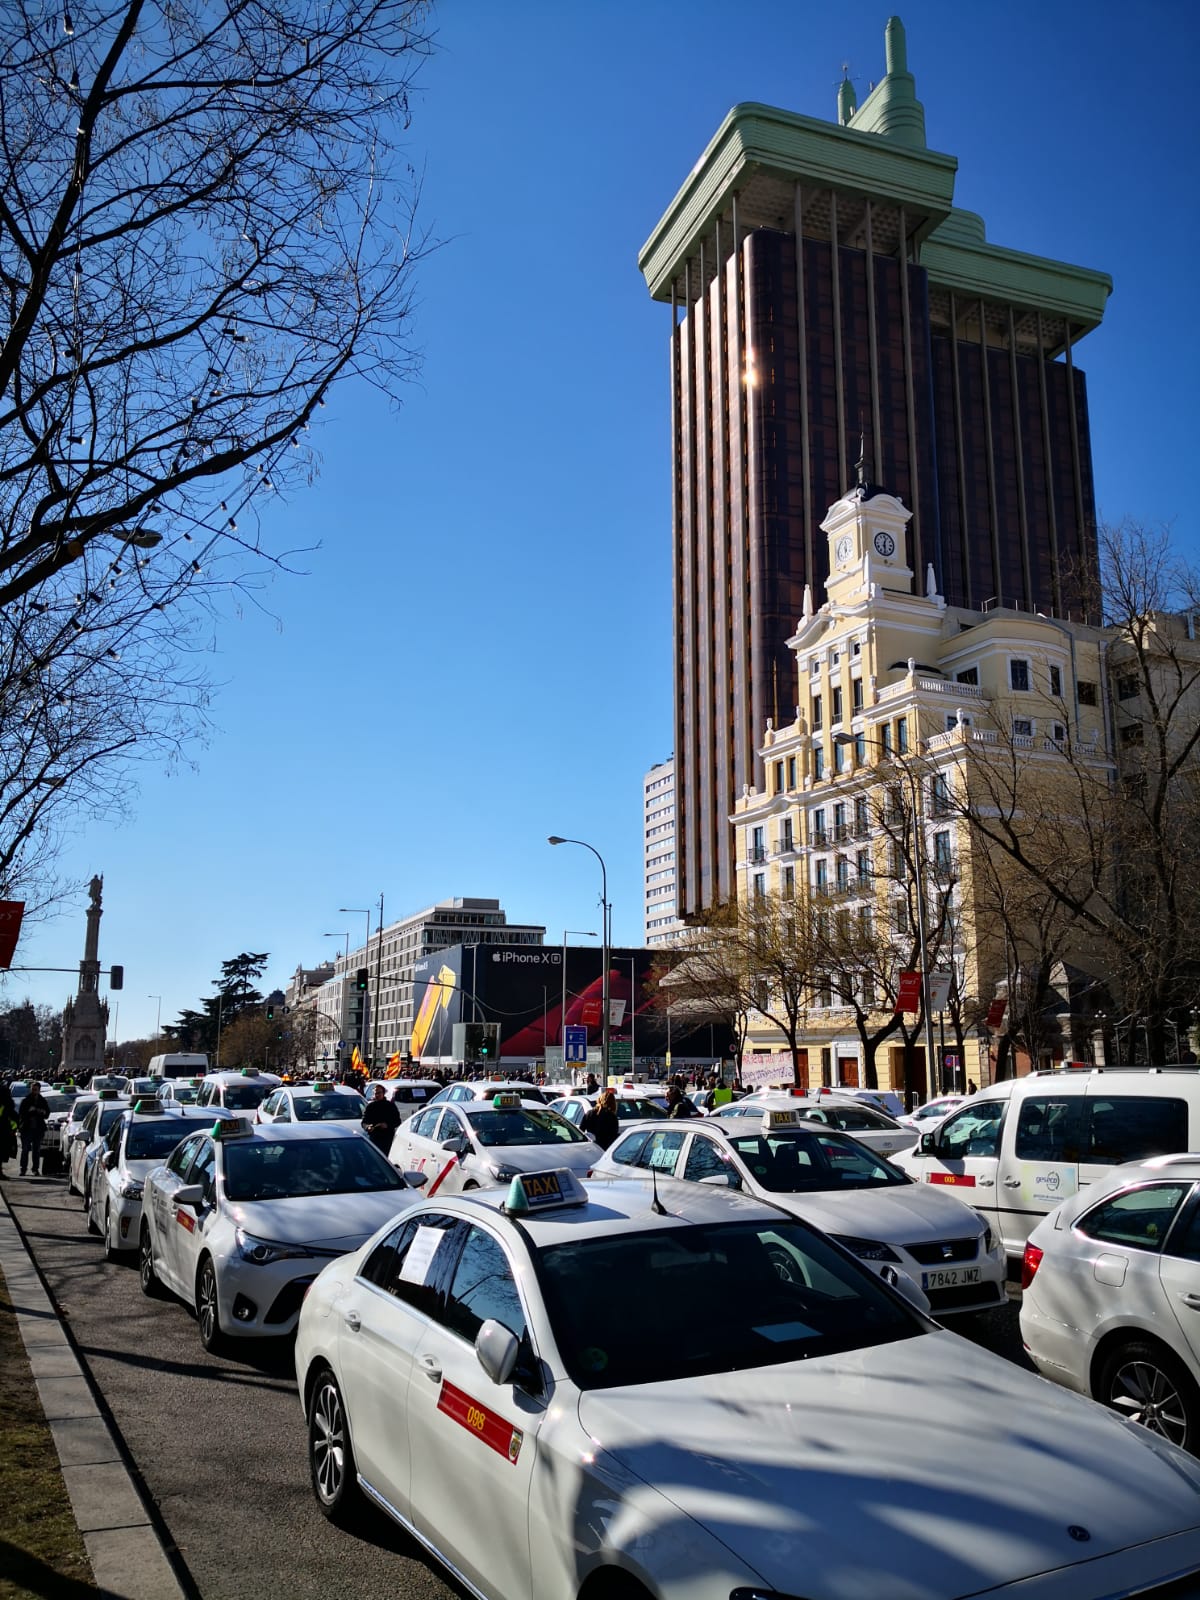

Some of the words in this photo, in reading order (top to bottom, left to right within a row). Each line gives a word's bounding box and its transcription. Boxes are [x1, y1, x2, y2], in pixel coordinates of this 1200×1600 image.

[502, 951, 540, 964] iPhone
[523, 1175, 560, 1197] TAXI
[930, 1271, 958, 1287] 7842
[961, 1268, 980, 1284] JMZ
[467, 1406, 486, 1431] 098
